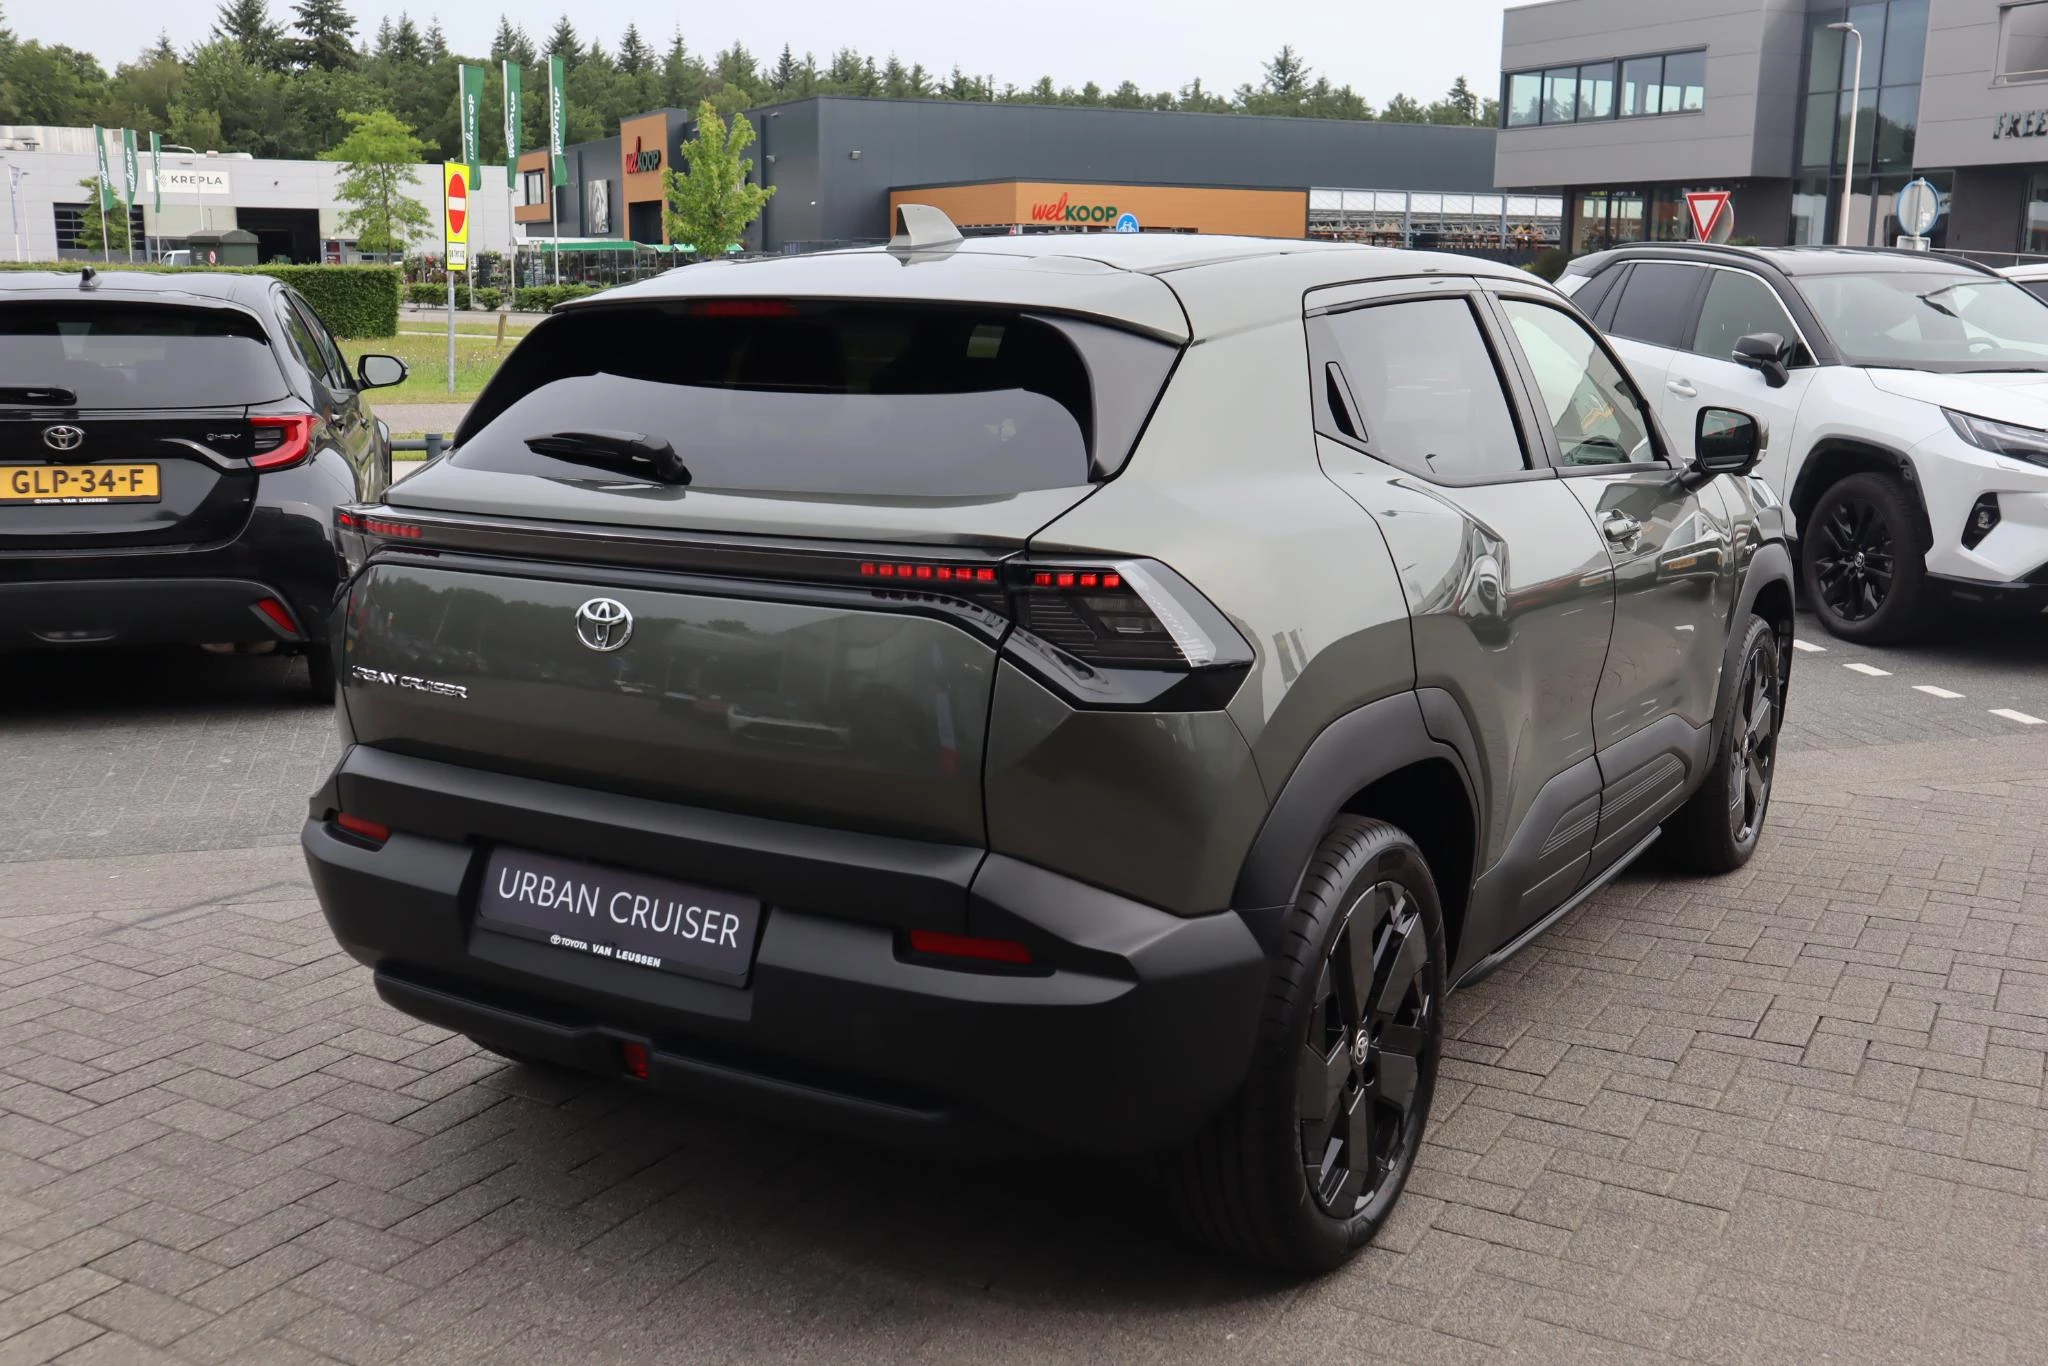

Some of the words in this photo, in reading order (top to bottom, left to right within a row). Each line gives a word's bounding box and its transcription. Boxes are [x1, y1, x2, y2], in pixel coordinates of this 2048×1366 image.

[171, 175, 223, 185] KREPLA
[11, 468, 145, 494] GLP-34-F
[498, 867, 600, 917] URBAN
[609, 891, 740, 948] CRUISER
[561, 937, 588, 950] TOYOTA
[592, 944, 612, 956] VAN
[615, 949, 661, 968] LEUSSEN
